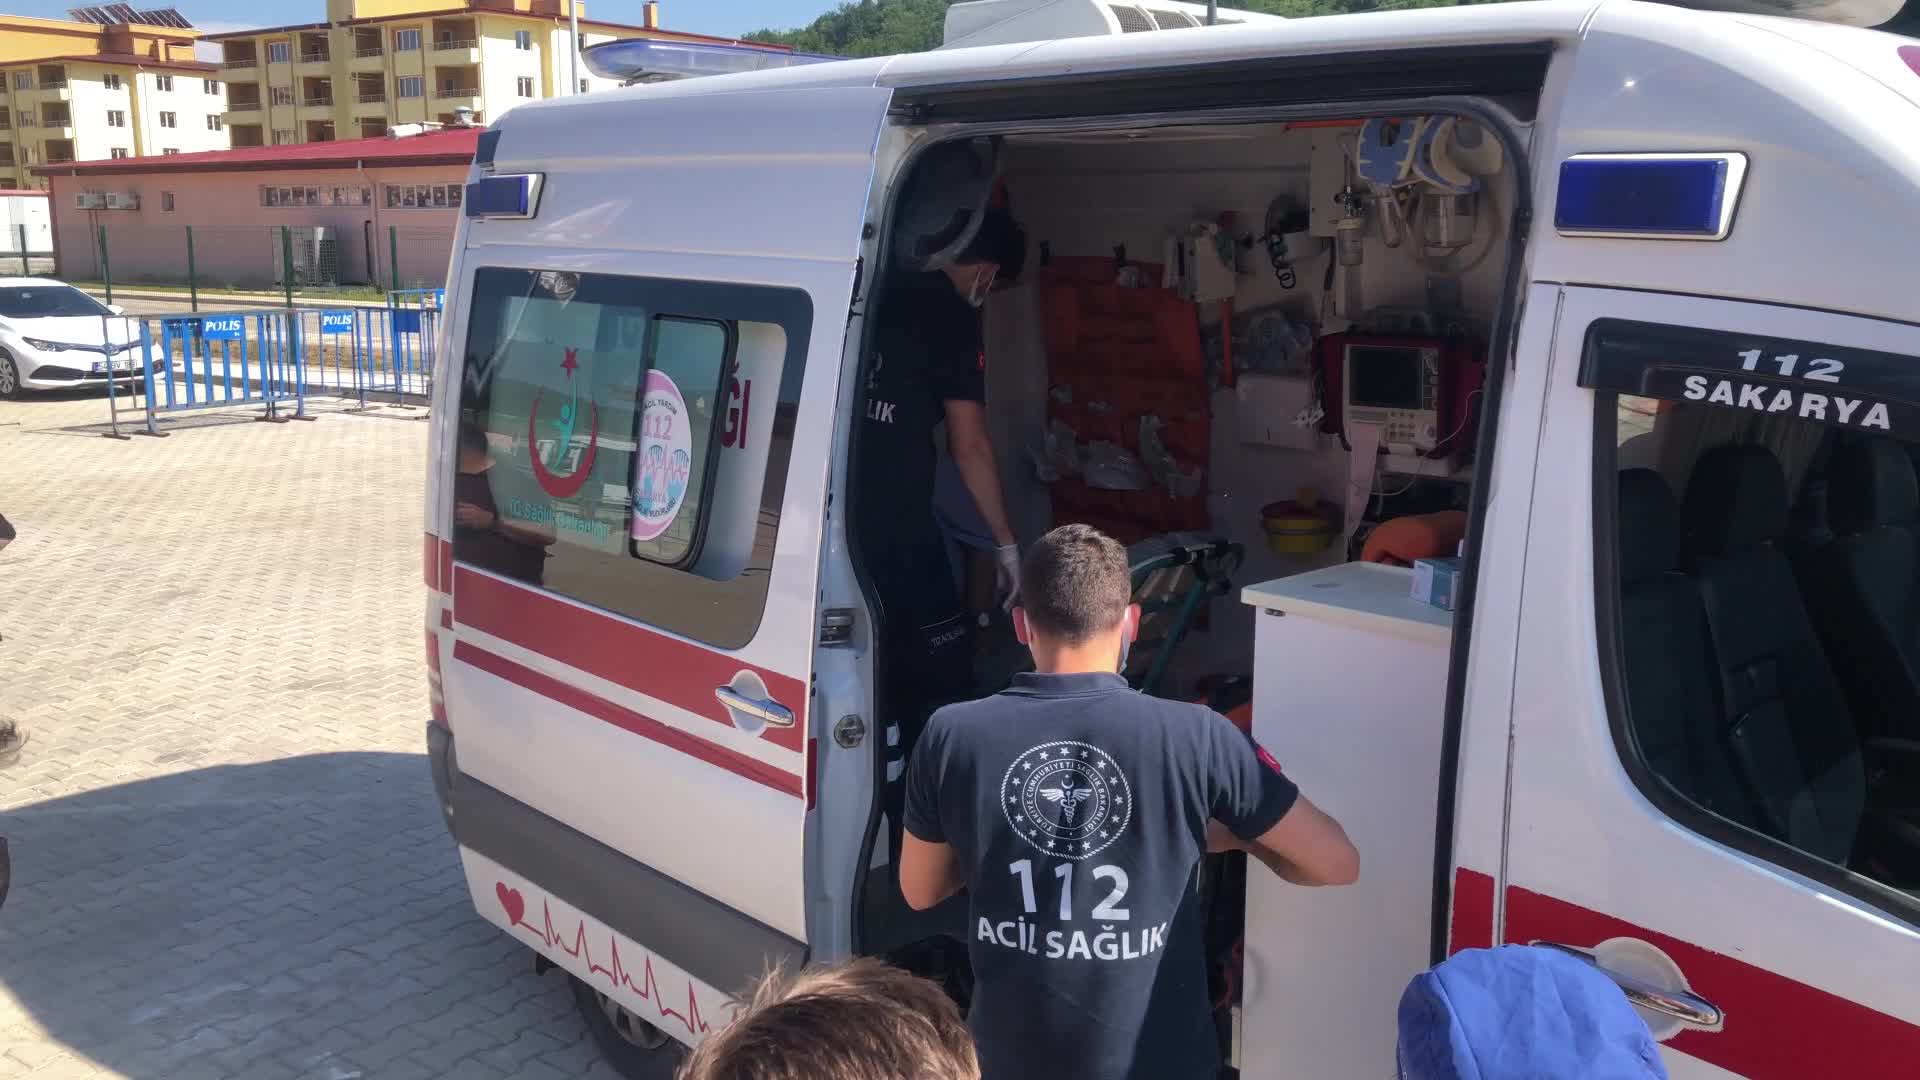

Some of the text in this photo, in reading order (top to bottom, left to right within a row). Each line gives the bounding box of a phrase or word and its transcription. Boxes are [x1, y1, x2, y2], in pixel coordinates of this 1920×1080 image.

[1738, 349, 1845, 383] 112
[1683, 375, 1890, 430] SAKARYA
[1009, 859, 1130, 920] 112
[977, 915, 1167, 960] ACİL SAĞLIK
